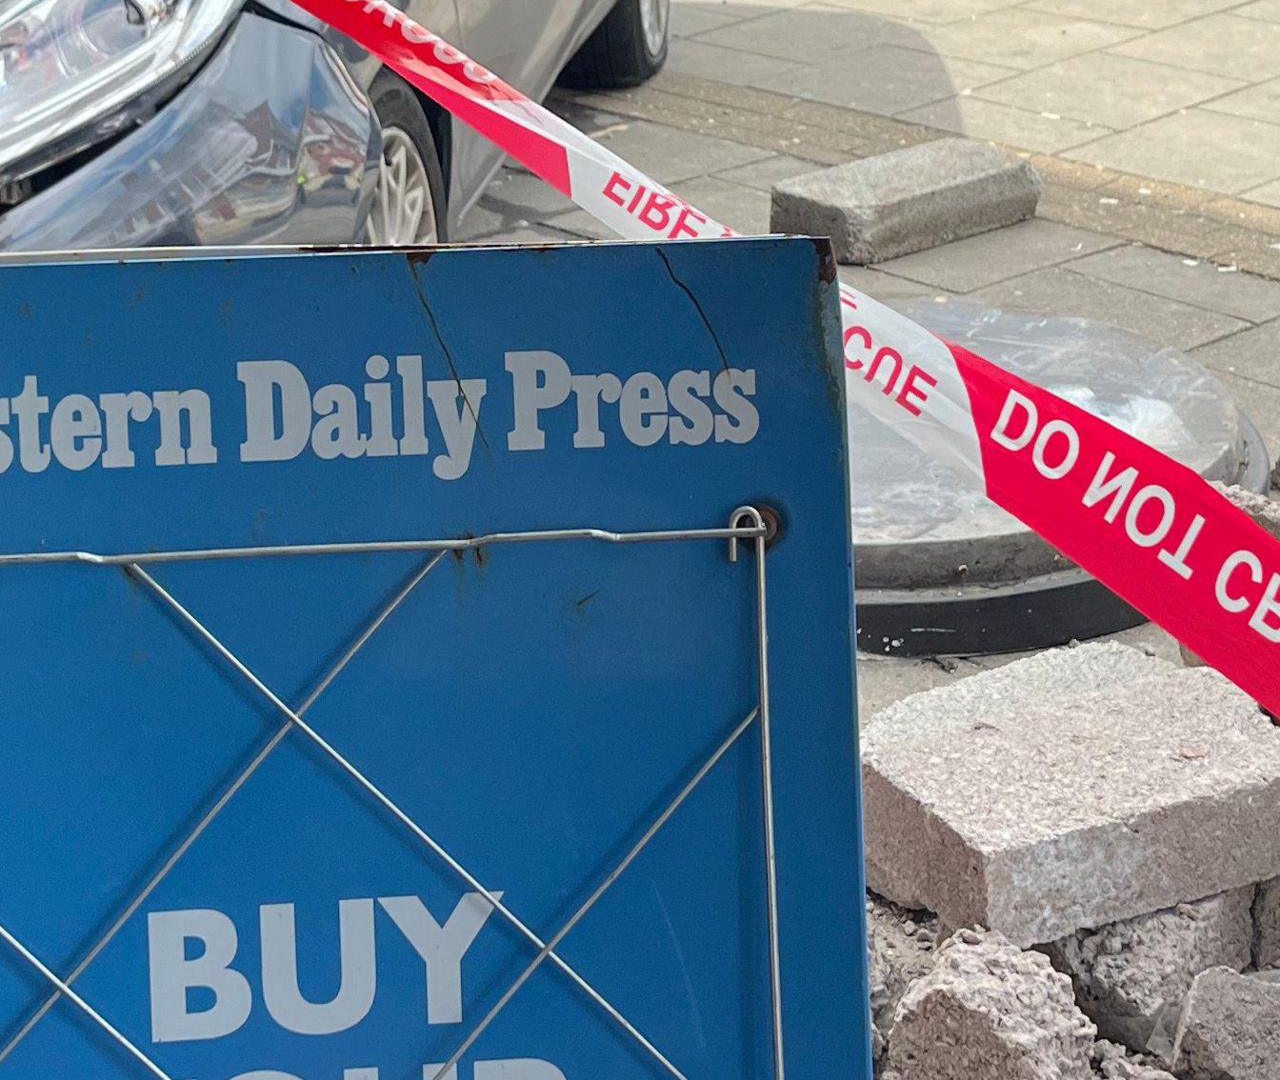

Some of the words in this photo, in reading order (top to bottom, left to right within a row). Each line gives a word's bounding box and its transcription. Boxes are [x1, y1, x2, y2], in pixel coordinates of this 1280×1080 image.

[237, 354, 488, 480] Daily
[505, 350, 760, 451] Press
[148, 890, 505, 1043] BUY
